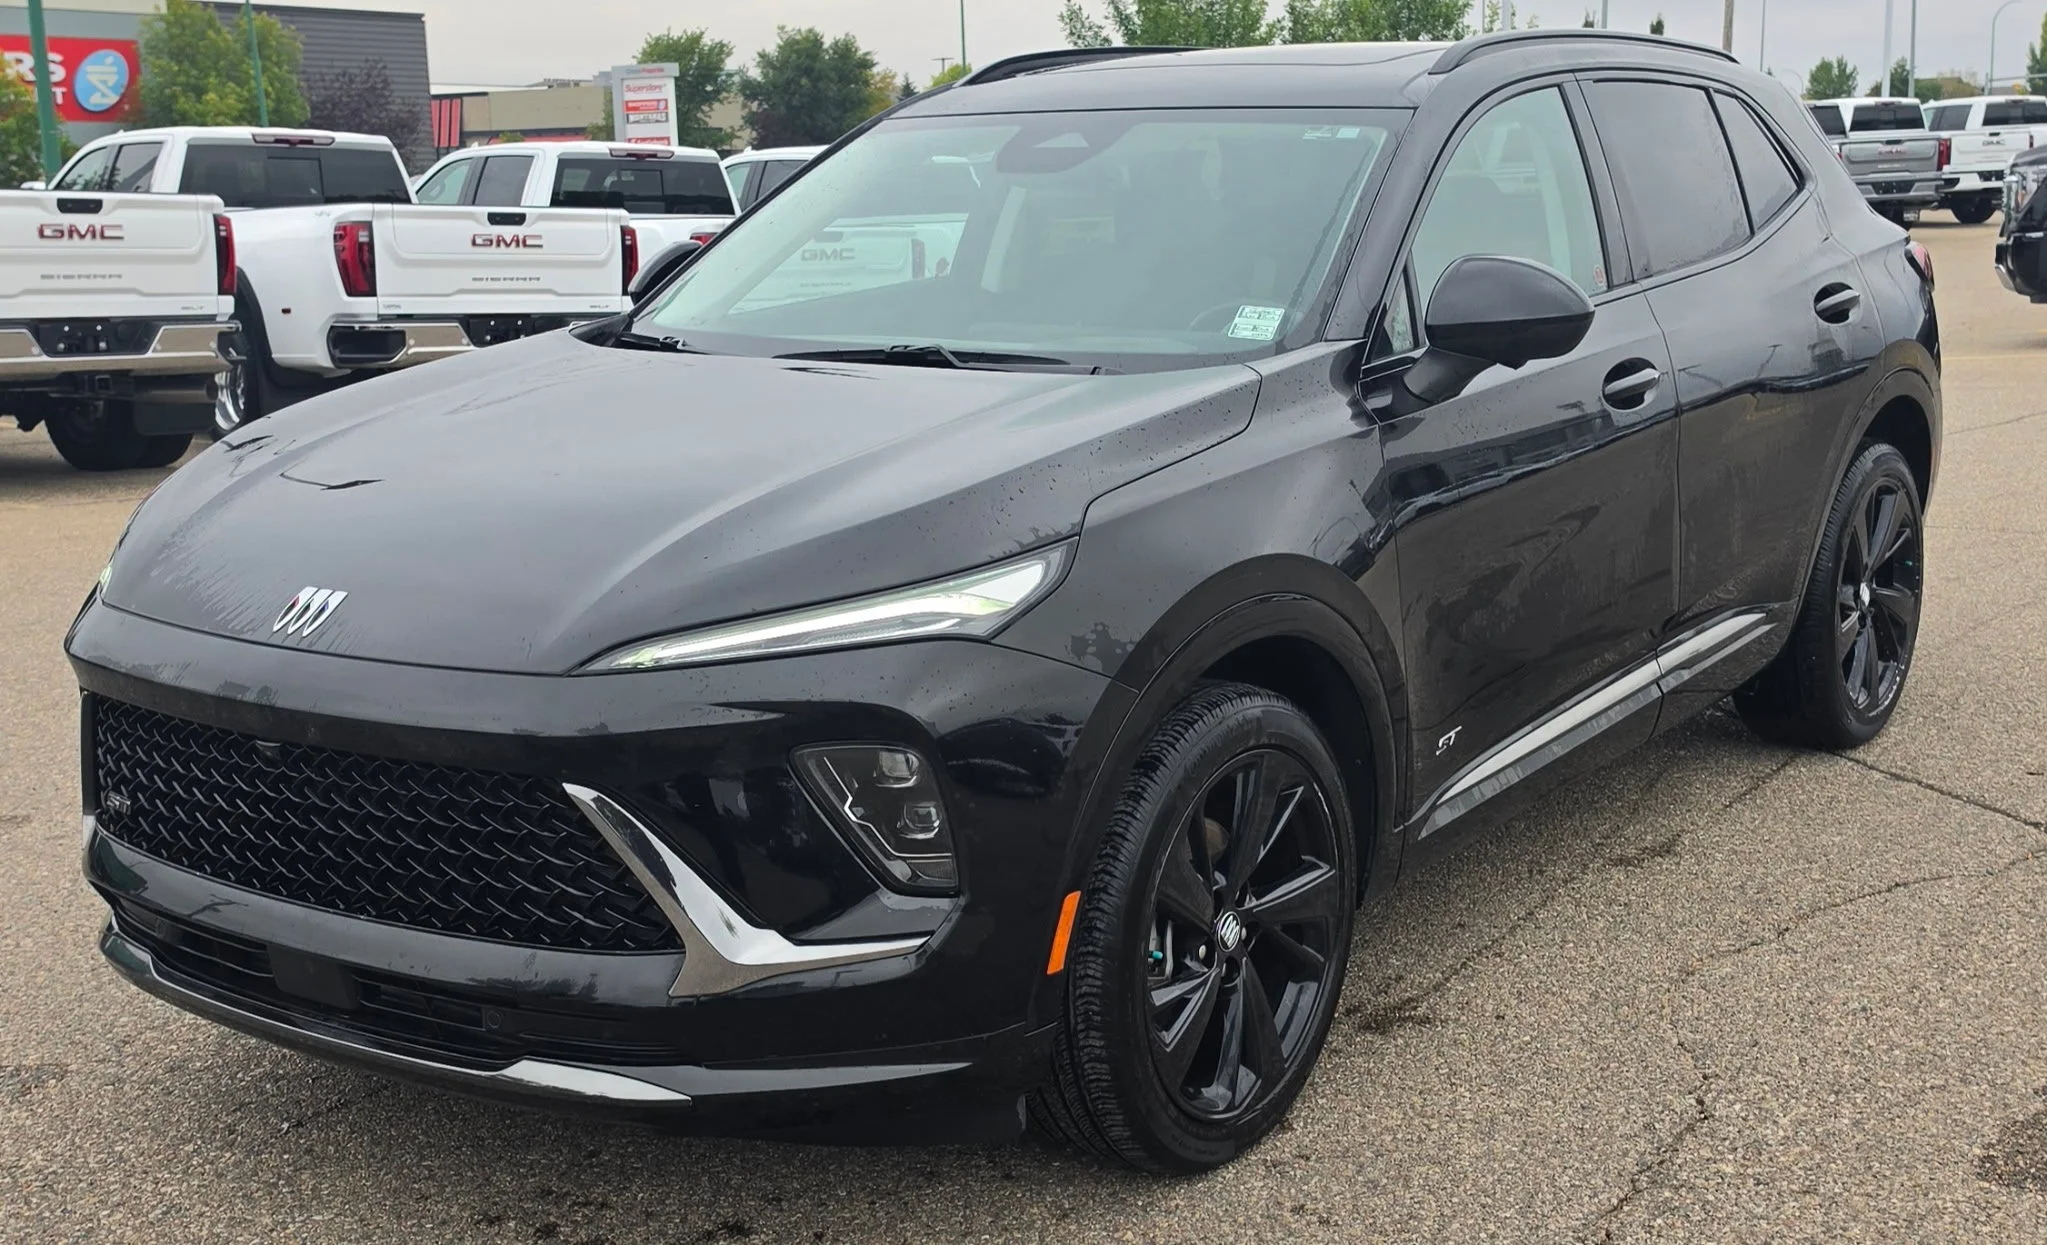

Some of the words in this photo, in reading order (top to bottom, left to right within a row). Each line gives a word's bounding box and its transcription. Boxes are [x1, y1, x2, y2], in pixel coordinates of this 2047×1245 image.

[38, 224, 125, 240] GMC
[471, 234, 543, 248] GMC
[801, 248, 856, 261] GMC
[1436, 725, 1462, 756] ST
